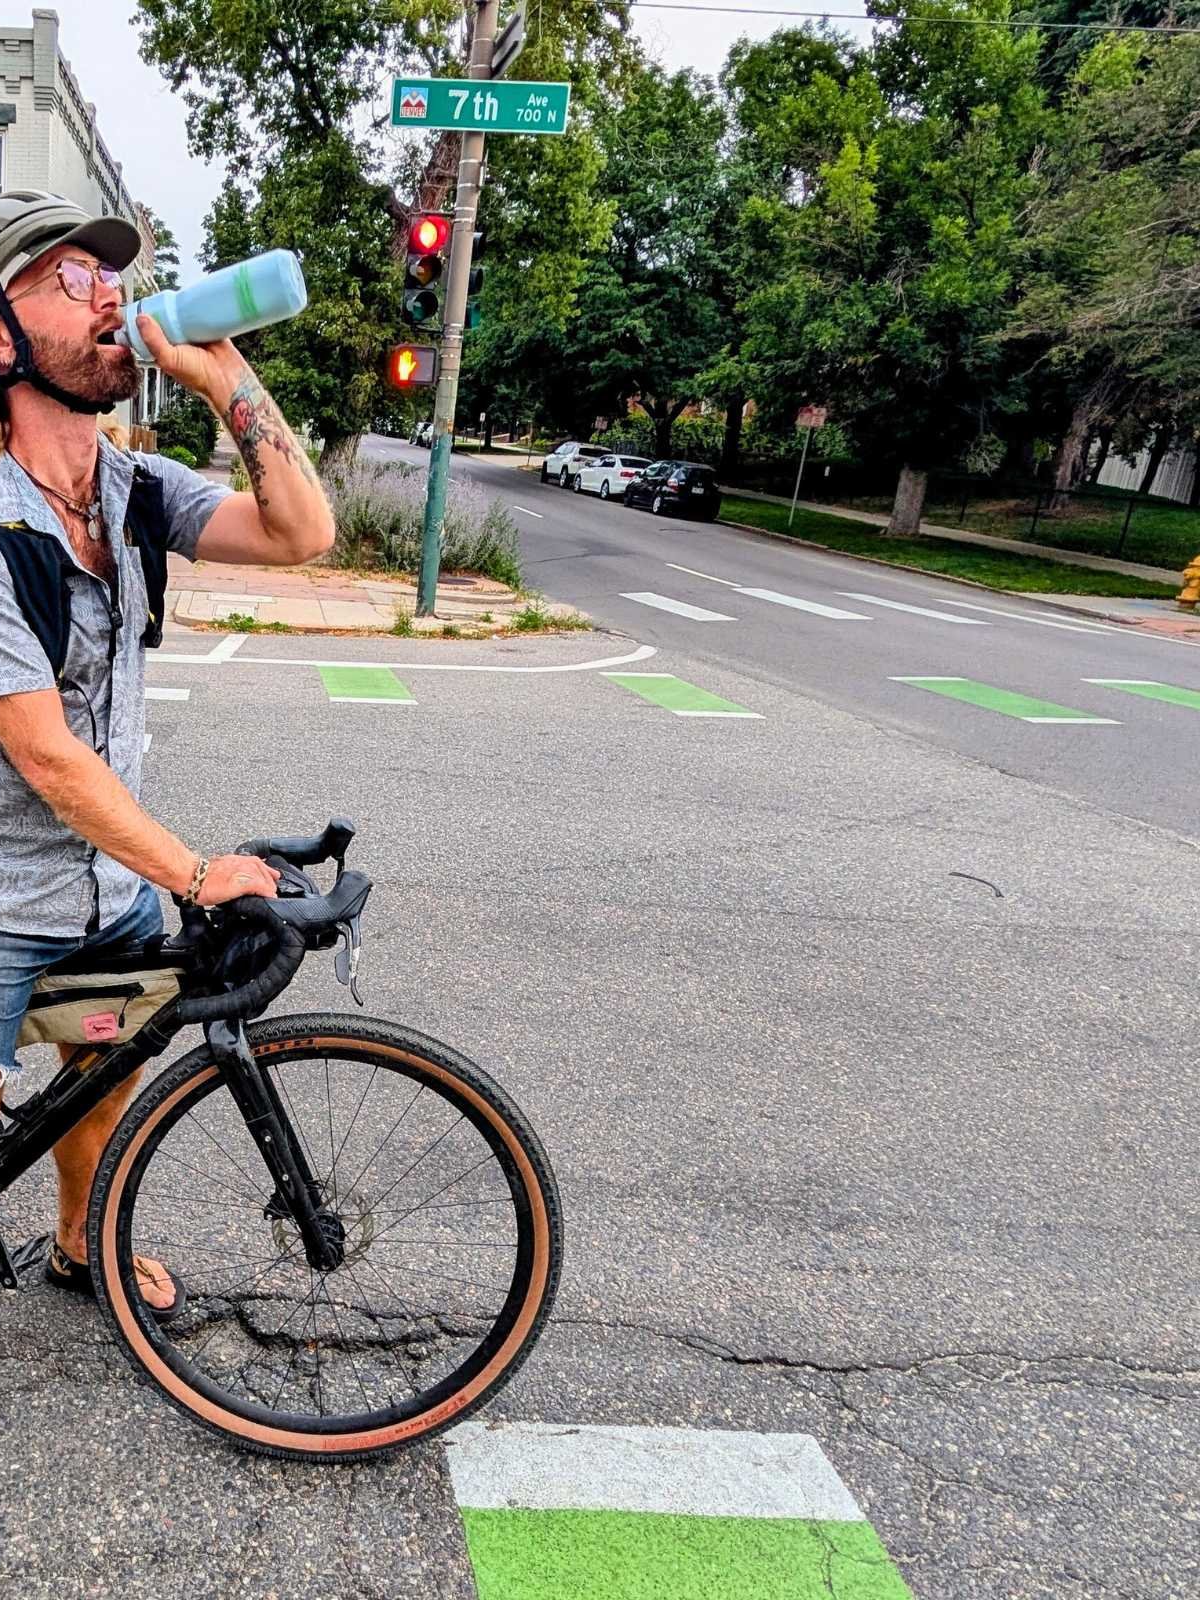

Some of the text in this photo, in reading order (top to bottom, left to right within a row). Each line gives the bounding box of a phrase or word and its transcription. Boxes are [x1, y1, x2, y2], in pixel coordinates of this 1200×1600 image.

[448, 89, 549, 121] 7th Ave
[515, 108, 557, 123] 700 N
